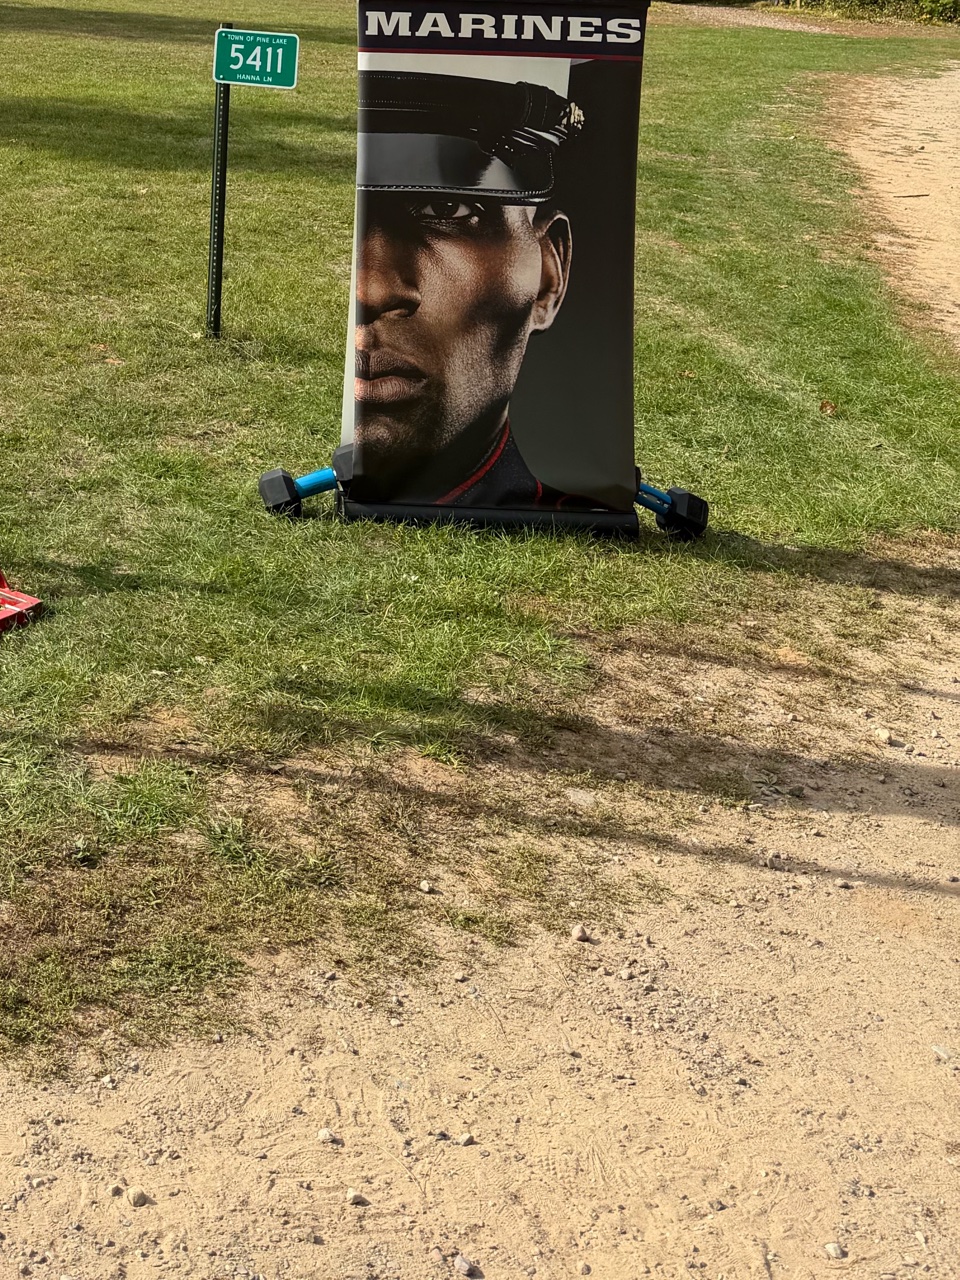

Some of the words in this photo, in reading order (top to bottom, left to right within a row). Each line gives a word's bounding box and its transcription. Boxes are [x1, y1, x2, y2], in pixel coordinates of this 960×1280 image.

[365, 11, 641, 43] MARINES
[229, 43, 283, 74] 5411
[236, 73, 260, 81] HANNA
